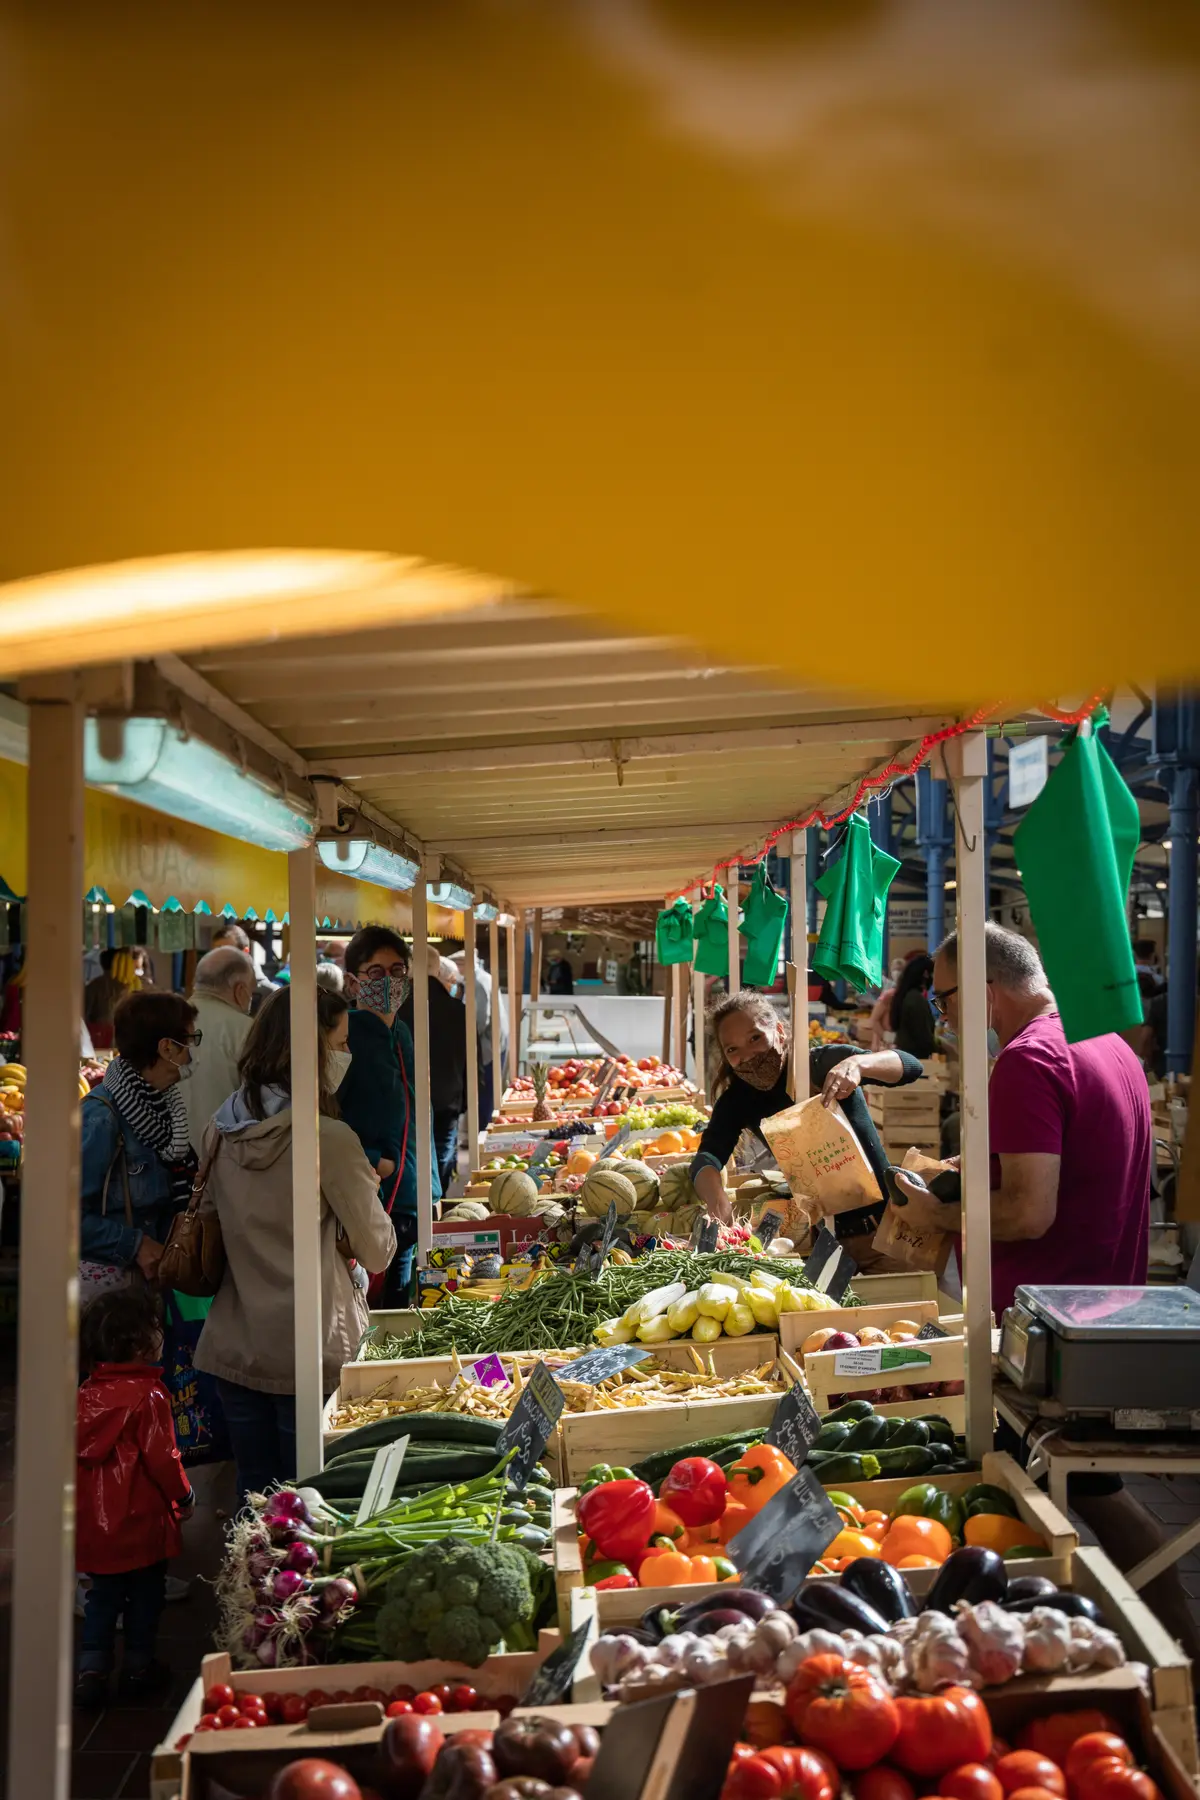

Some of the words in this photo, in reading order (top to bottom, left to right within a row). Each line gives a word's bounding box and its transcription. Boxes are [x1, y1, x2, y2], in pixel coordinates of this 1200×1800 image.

[806, 1141, 836, 1158] Fruits
[839, 1136, 847, 1144] &
[810, 1145, 850, 1167] Légumes
